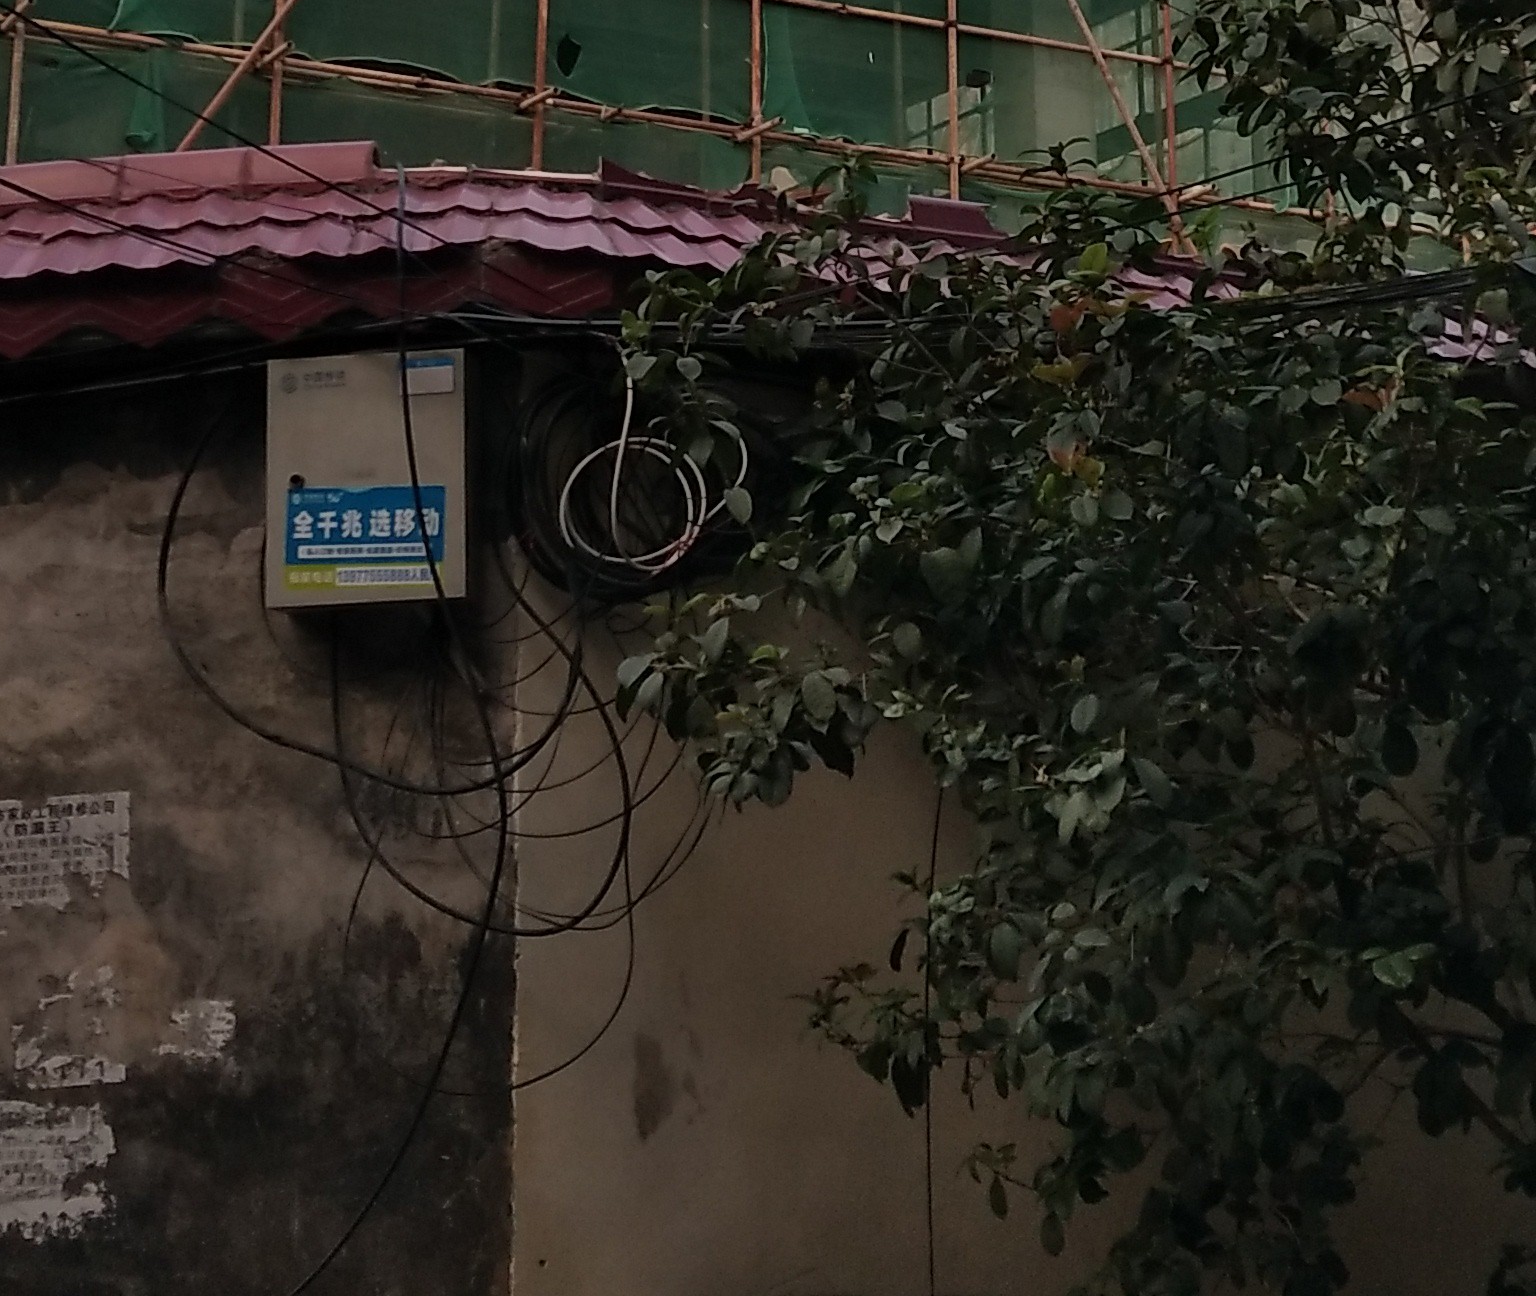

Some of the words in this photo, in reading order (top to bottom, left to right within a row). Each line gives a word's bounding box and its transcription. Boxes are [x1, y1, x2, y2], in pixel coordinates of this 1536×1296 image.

[292, 509, 363, 540] 全千兆
[368, 507, 440, 538] 选移动
